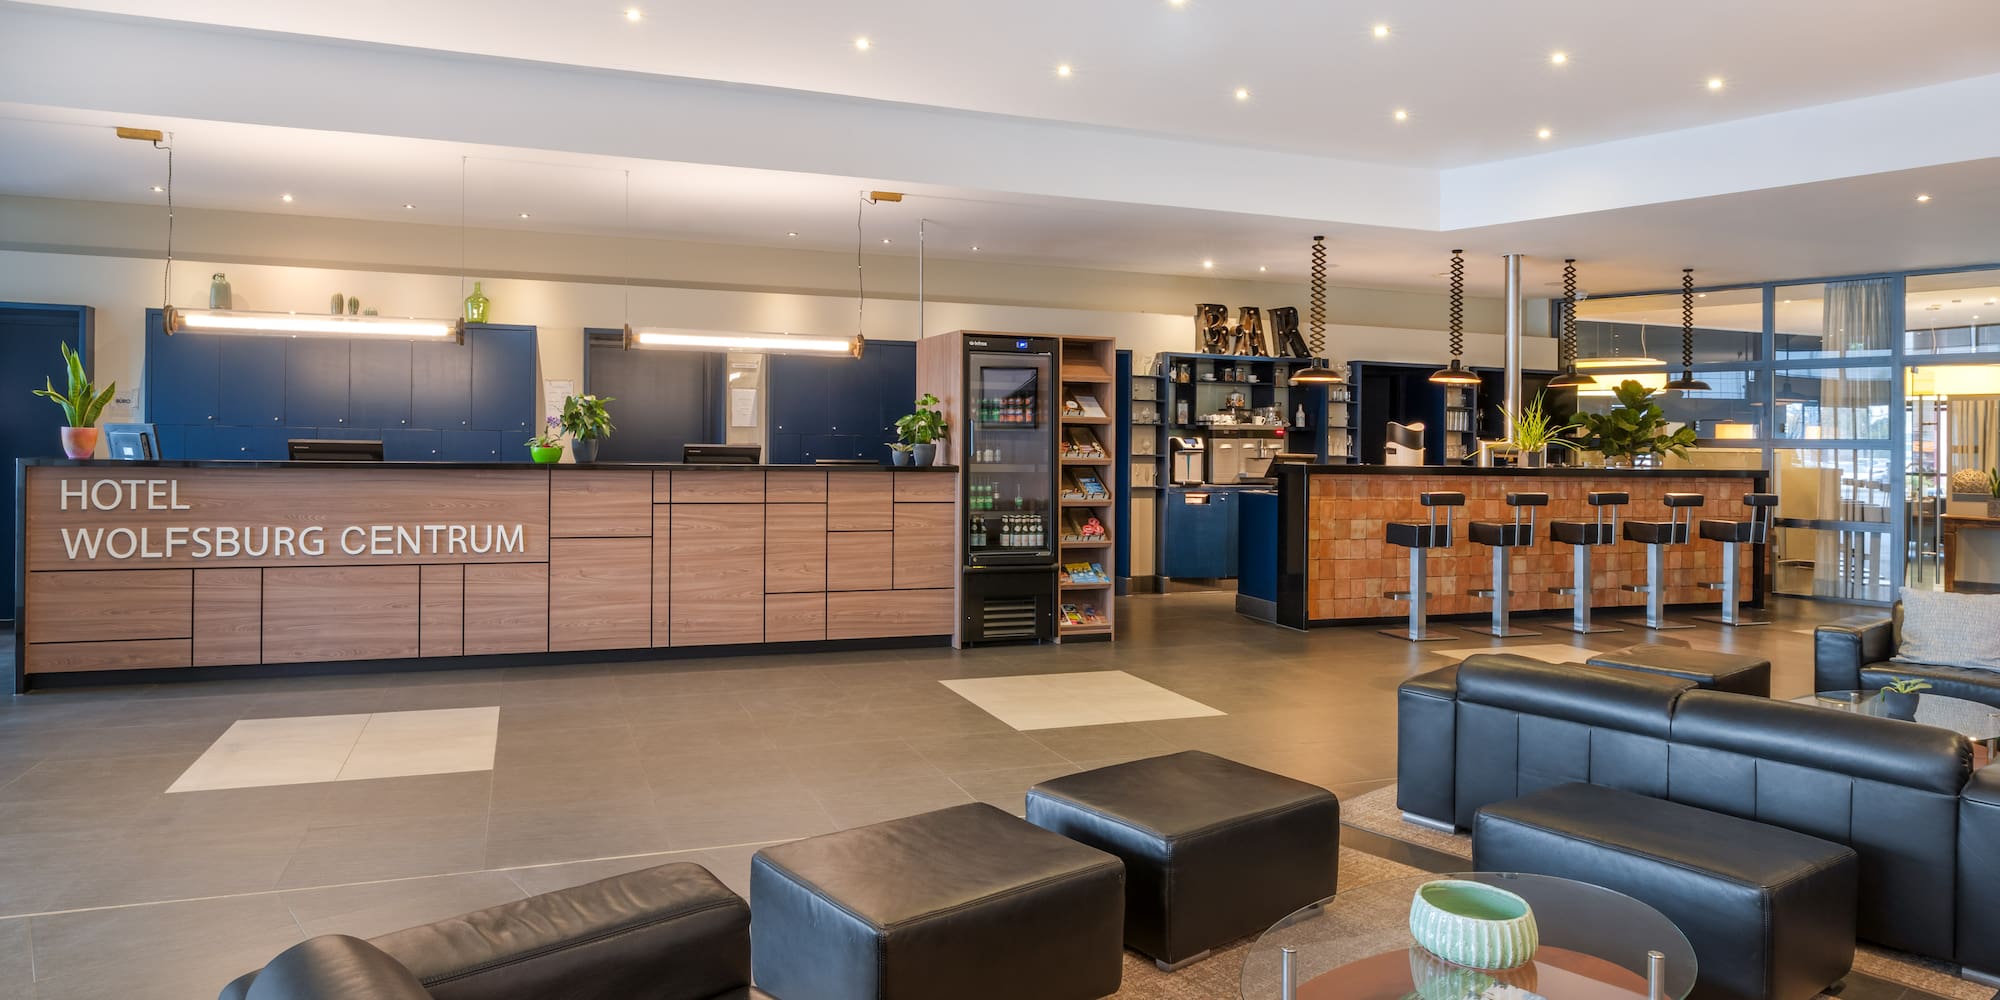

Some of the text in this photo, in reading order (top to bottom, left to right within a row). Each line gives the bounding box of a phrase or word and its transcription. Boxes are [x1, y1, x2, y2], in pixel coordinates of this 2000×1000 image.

[1194, 303, 1312, 357] BAR
[60, 479, 191, 511] HOTEL
[60, 524, 525, 560] WOLFSBURG CENTRUM
